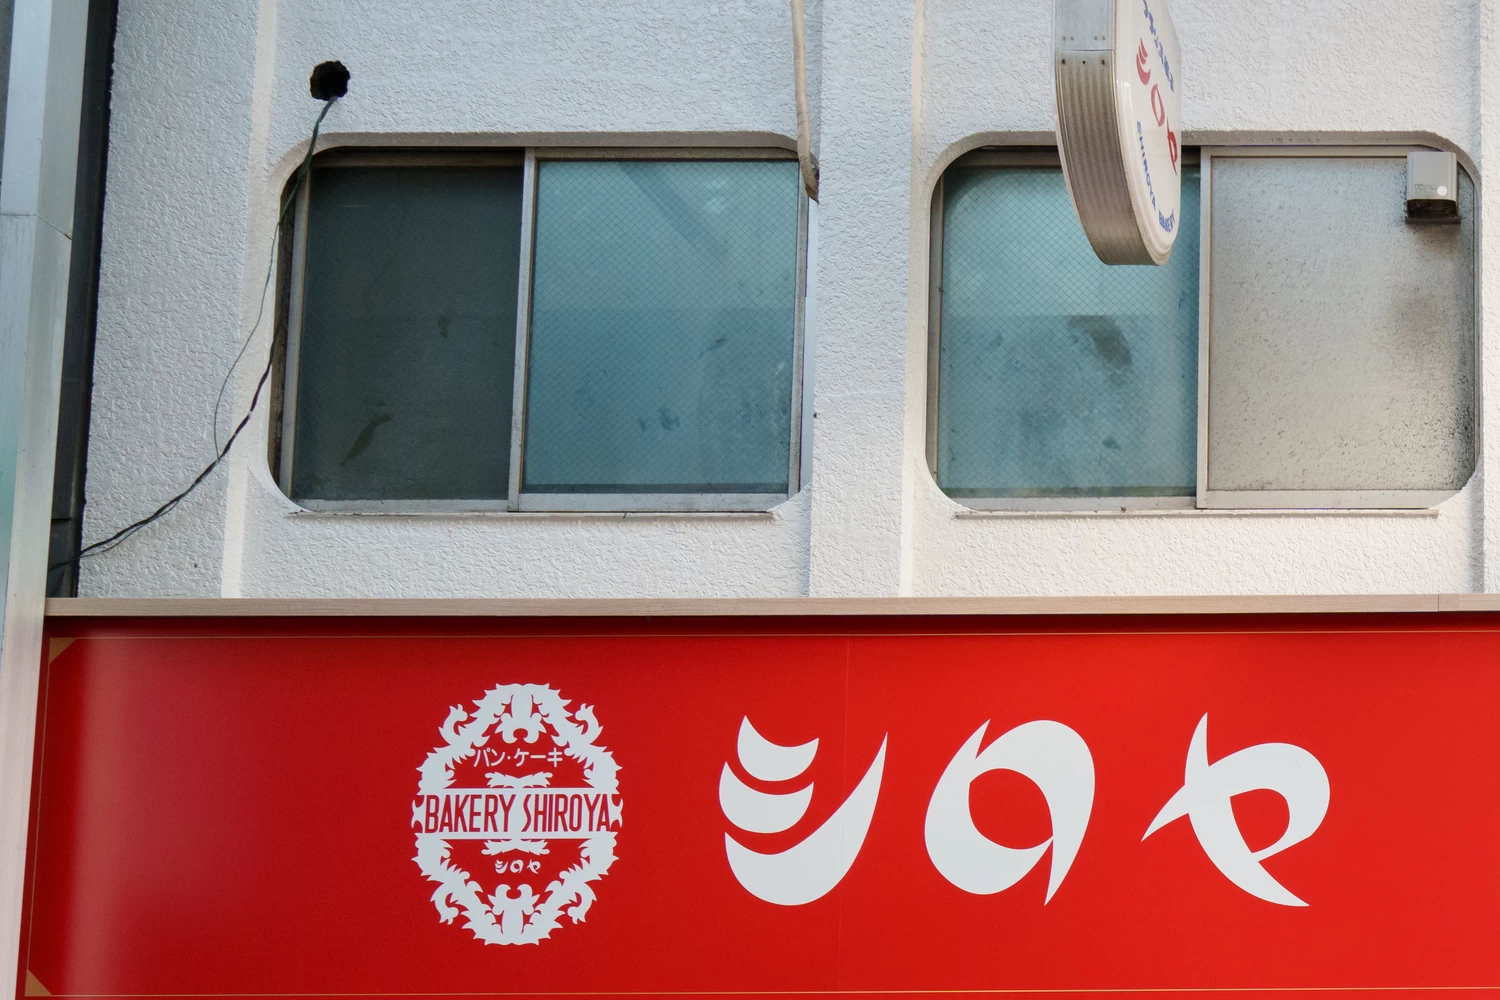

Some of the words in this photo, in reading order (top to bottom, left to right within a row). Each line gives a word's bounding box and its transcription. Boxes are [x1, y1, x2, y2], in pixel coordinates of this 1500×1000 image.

[1136, 121, 1156, 211] SHIROYA
[1158, 208, 1175, 233] BAKERY
[474, 748, 563, 767] パン・ケーキ
[424, 794, 516, 833] BAKERY
[521, 793, 611, 833] SHIROYA
